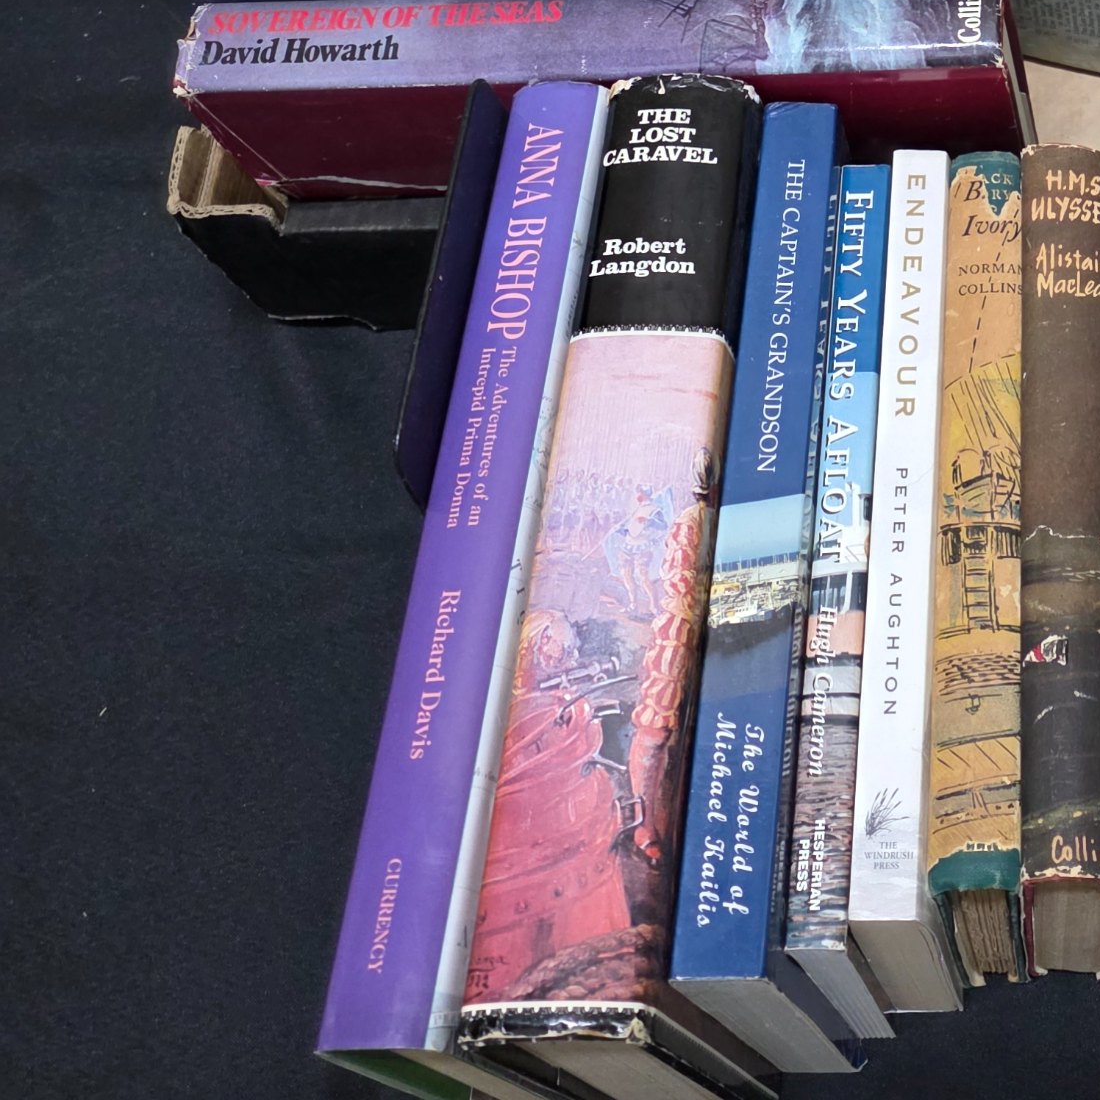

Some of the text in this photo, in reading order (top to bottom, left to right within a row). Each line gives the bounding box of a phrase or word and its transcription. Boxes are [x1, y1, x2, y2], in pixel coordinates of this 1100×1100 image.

[200, 34, 400, 67] David Howarth
[207, 0, 567, 37] SOVEREIGN OF THE SEAS
[602, 144, 718, 167] CARAVEL
[628, 127, 696, 145] LOST
[637, 108, 692, 125] THE
[487, 123, 564, 340] ANNA BISHOP
[588, 256, 696, 278] Langdon
[602, 237, 686, 256] Robert
[840, 190, 874, 277] FIFTY
[757, 159, 805, 473] THE CAPTAIN'S GRANDSON
[958, 282, 1022, 296] COLLINS
[829, 289, 869, 401] YEARS
[446, 347, 496, 529] Intrepid Prima Donna
[818, 414, 859, 563] AFLOAT
[883, 174, 926, 716] ENDEAVOUR PETER AUGHTON
[409, 589, 461, 760] Richard Davis
[807, 605, 838, 778] Hugh Cameron
[696, 711, 735, 928] Michael Kailis
[728, 723, 765, 916] The World of
[809, 819, 826, 912] HESPERIAN
[864, 850, 915, 861] WINDRUSH
[366, 857, 403, 974] CURRENCY
